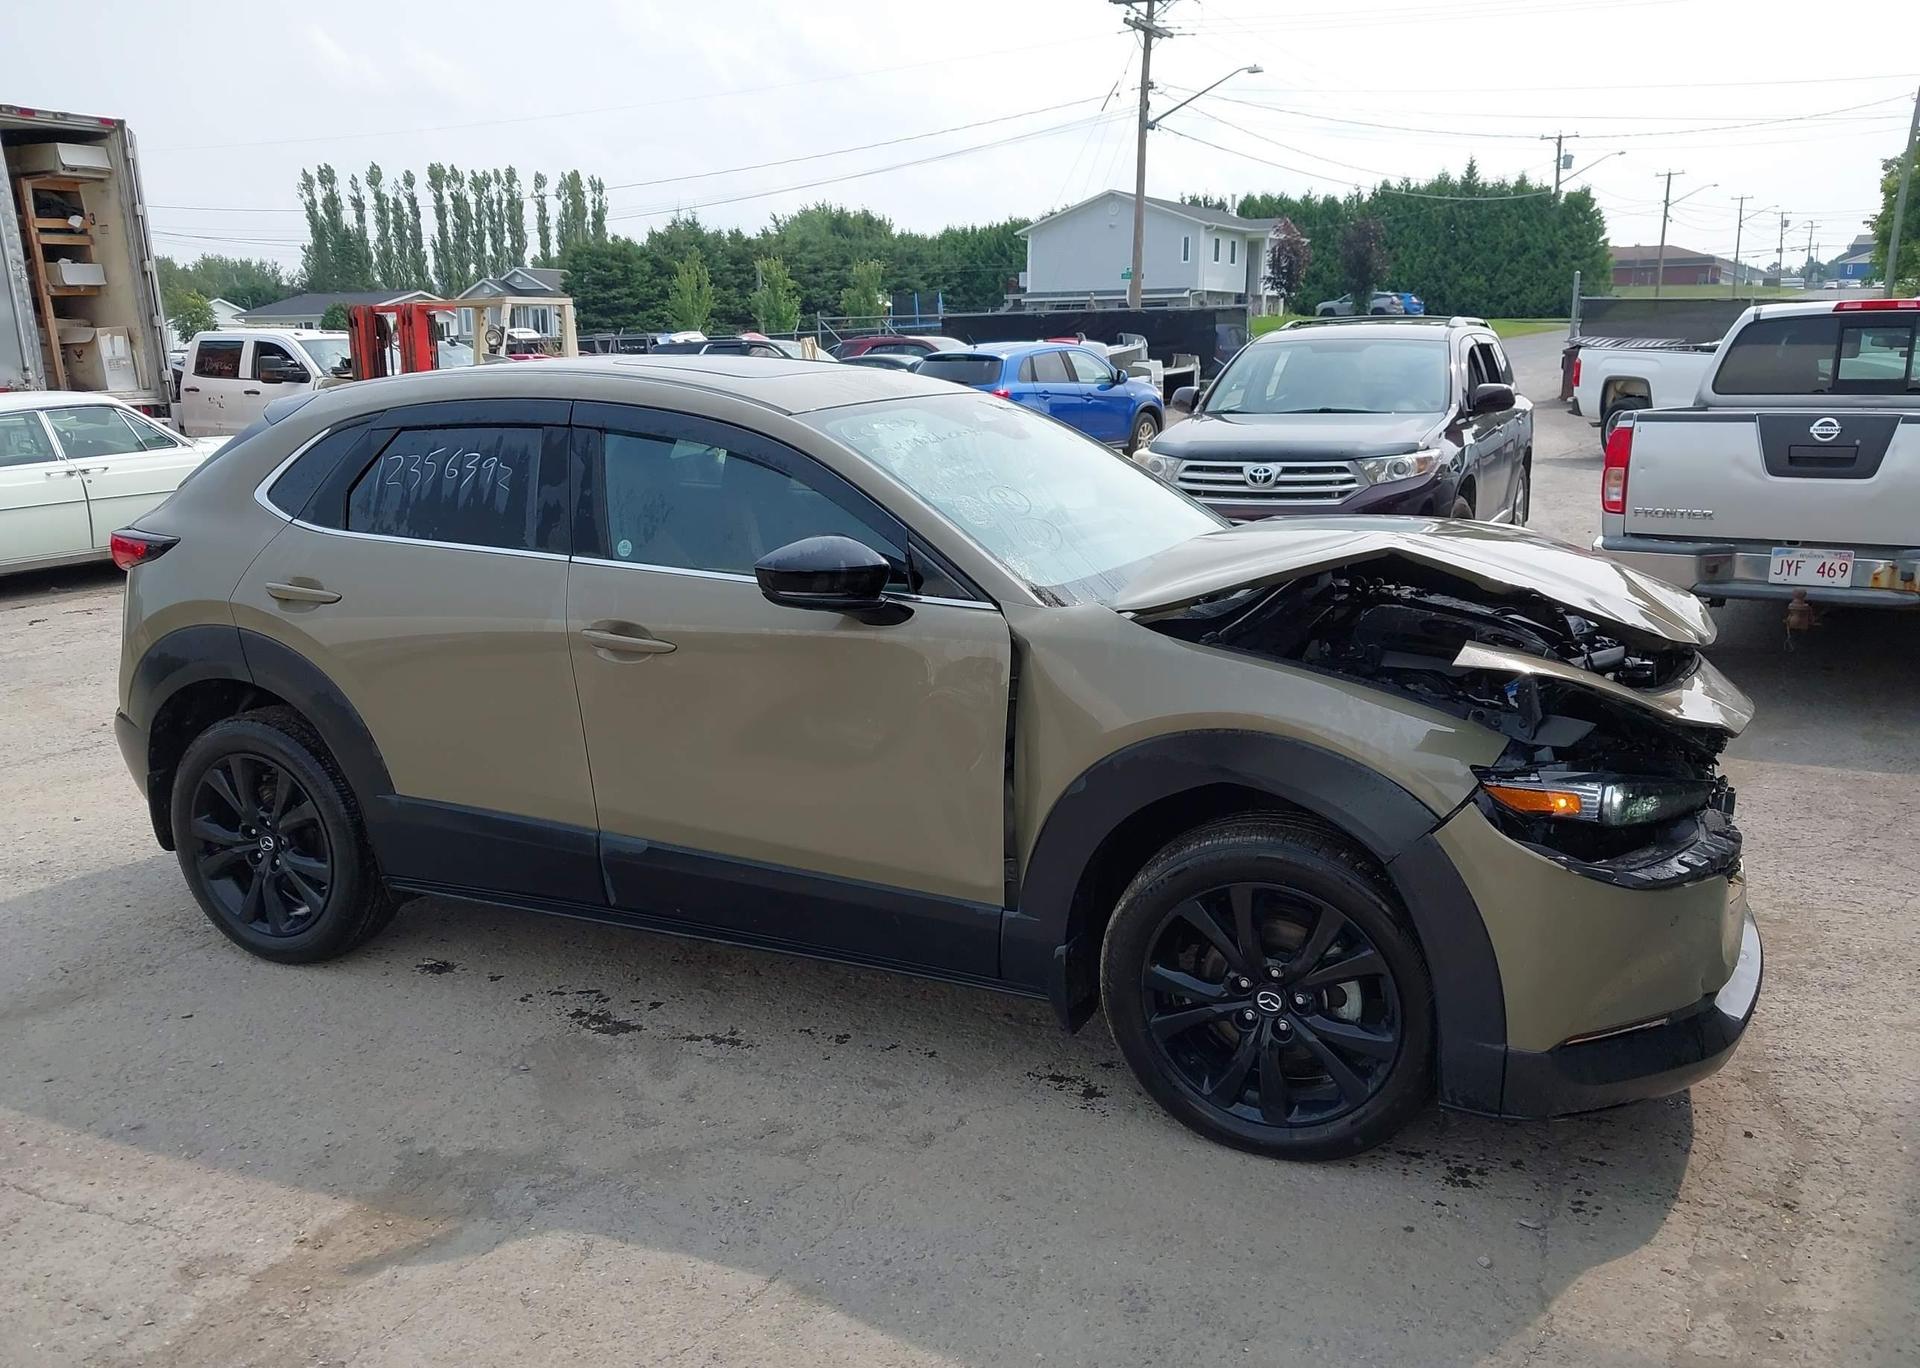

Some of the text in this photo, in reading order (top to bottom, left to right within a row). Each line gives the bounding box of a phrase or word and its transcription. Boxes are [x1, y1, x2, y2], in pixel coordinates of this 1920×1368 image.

[1633, 506, 1714, 521] FRONTIER
[1773, 559, 1849, 578] JYF 469
